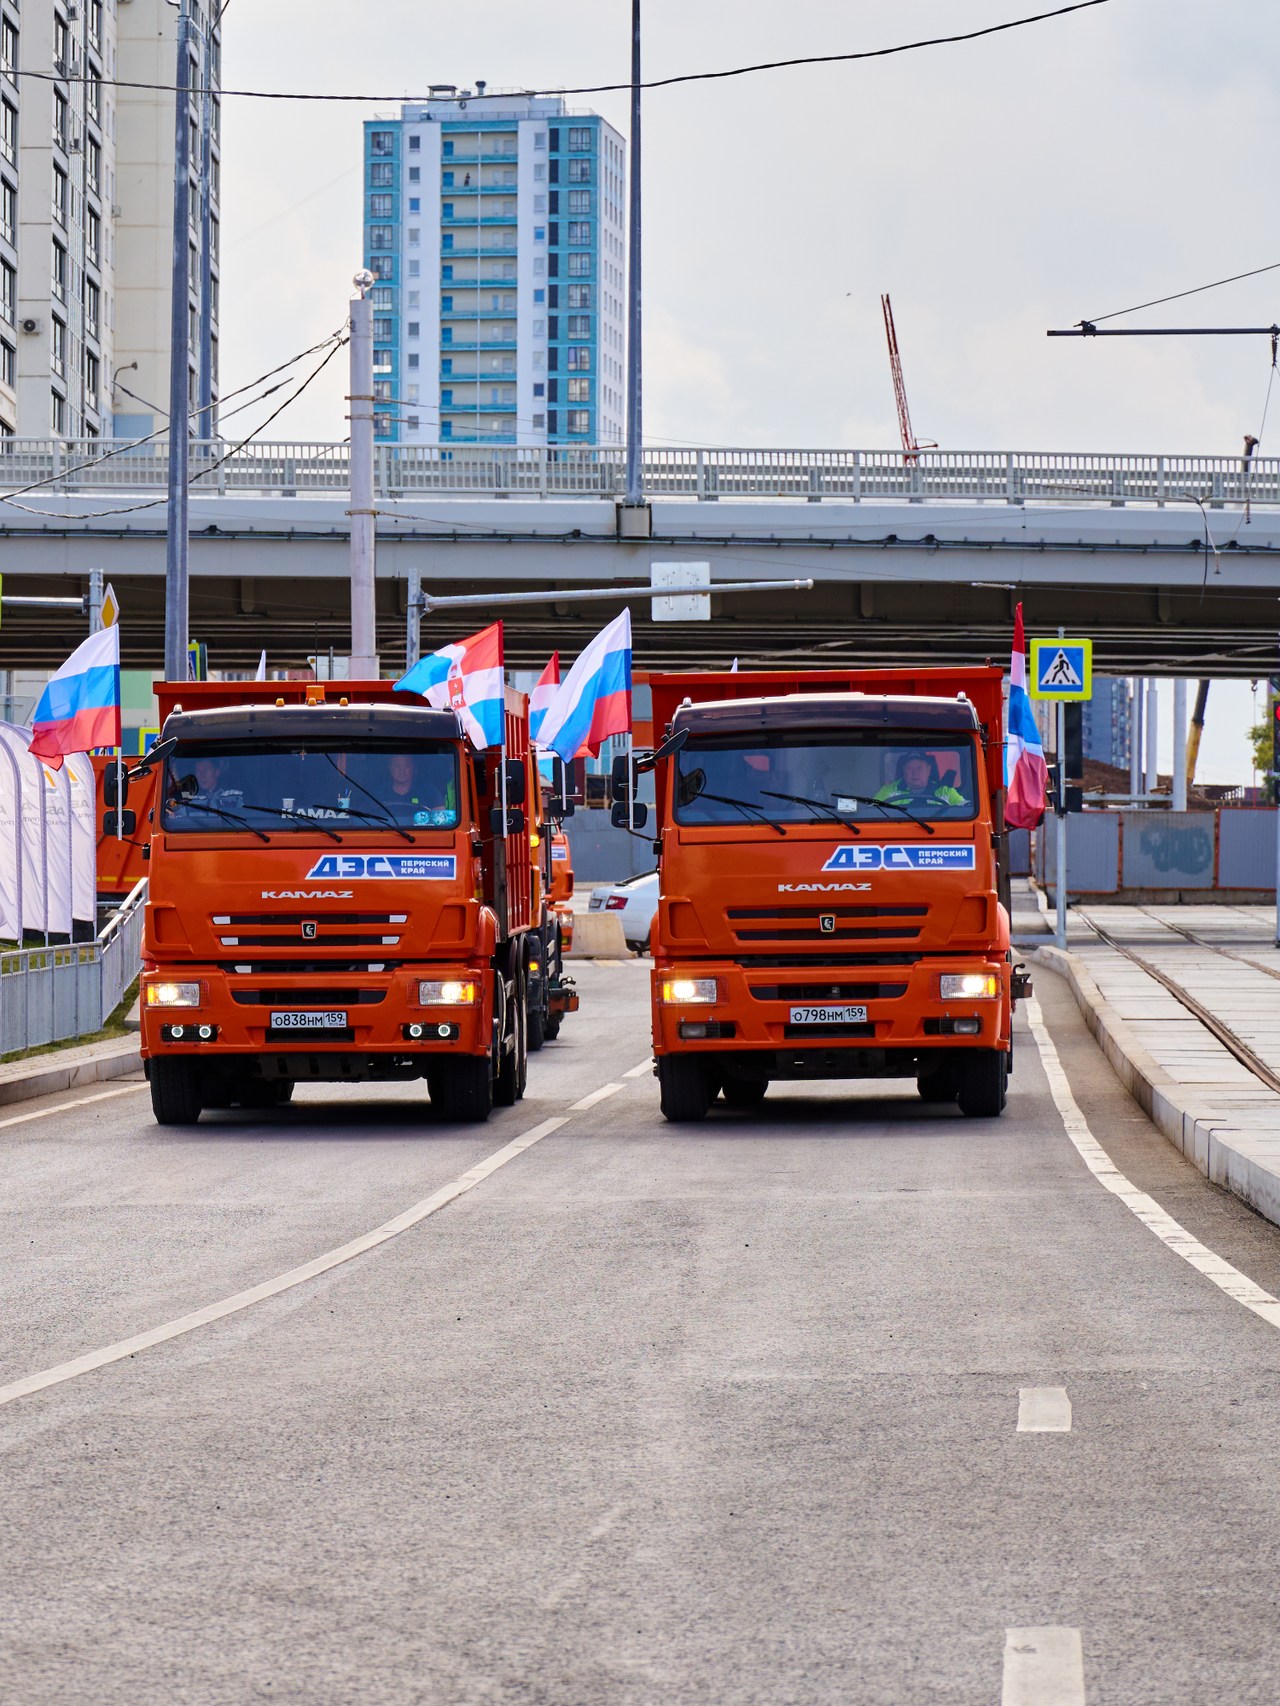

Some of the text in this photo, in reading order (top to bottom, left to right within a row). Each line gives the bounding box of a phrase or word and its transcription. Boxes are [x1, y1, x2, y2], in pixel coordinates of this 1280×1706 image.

[918, 849, 968, 858] ПЕРМСКИЙ
[400, 859, 450, 868] ПЕРМСКИЙ
[918, 857, 944, 865] КРАЙ
[400, 867, 426, 875] КРАЙ
[778, 882, 872, 892] KAMAZ
[261, 890, 354, 899] KAMAZ
[845, 1007, 864, 1018] 159
[325, 1012, 343, 1023] 159
